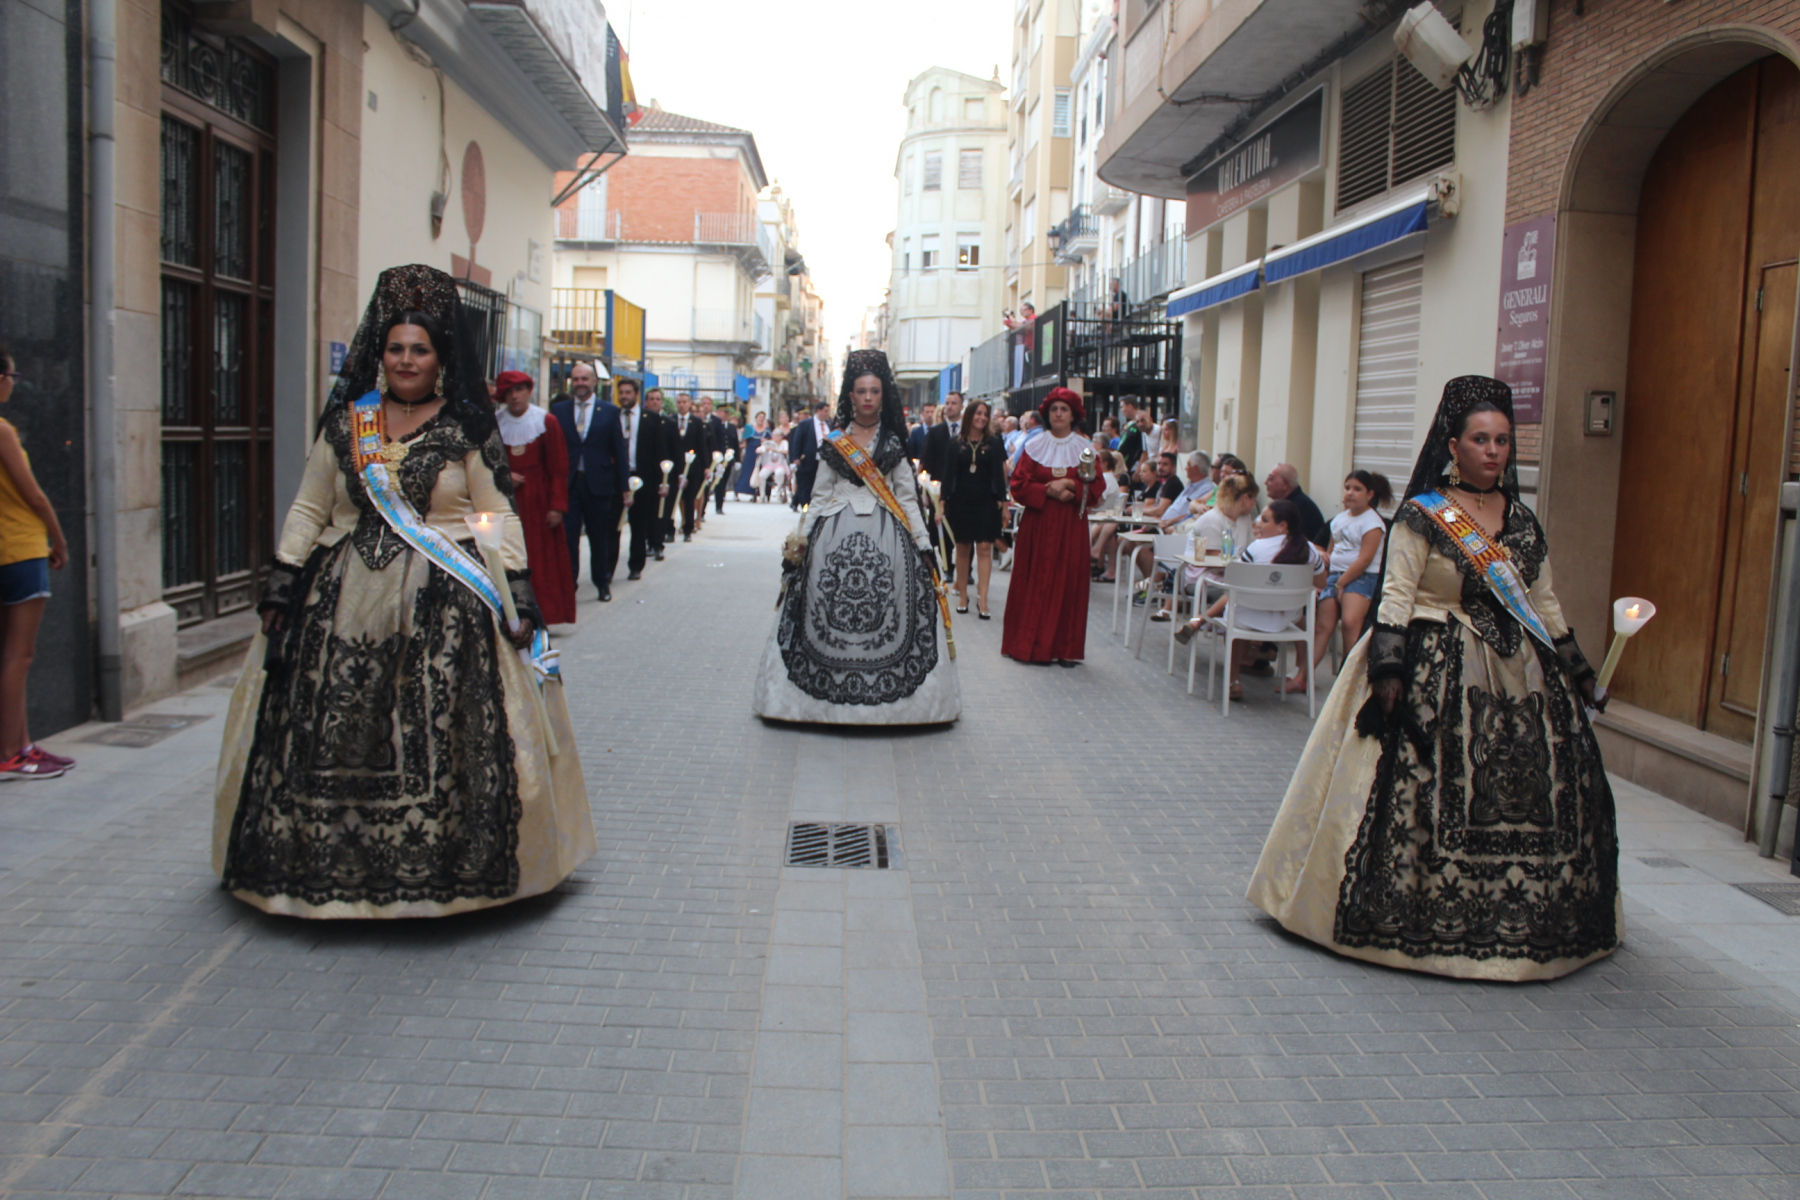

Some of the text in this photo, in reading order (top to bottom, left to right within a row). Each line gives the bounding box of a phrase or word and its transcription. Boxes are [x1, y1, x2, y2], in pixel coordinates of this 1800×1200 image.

[1218, 133, 1271, 196] VALENTINA
[1503, 284, 1547, 309] GENERALI
[1509, 310, 1538, 327] Seguros
